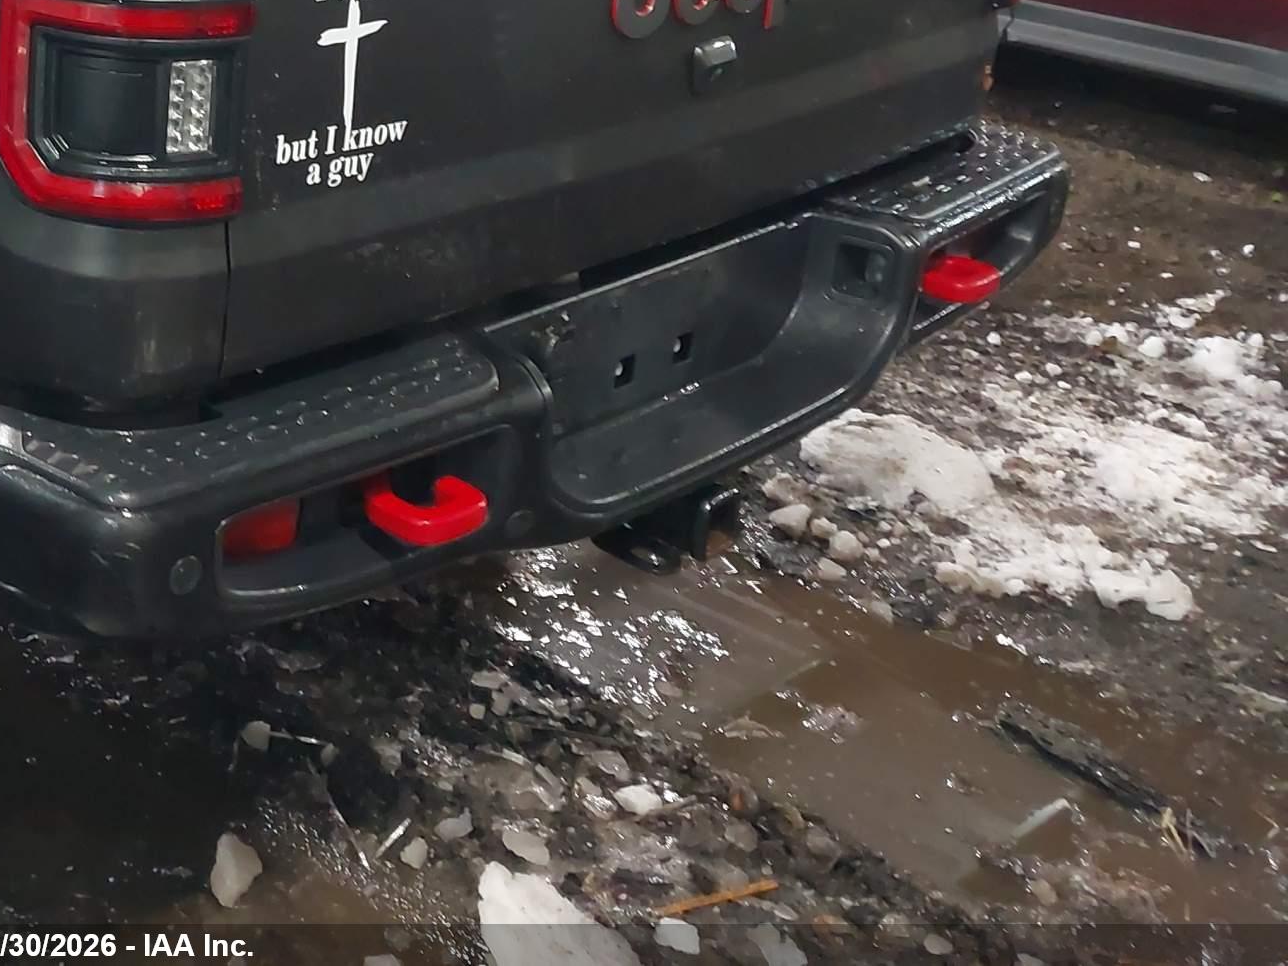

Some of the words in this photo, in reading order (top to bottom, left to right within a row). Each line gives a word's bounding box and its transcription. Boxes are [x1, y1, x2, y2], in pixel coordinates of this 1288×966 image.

[276, 129, 319, 165] but
[324, 125, 338, 155] I
[342, 120, 409, 152] know
[306, 163, 322, 186] a
[327, 152, 375, 188] guy
